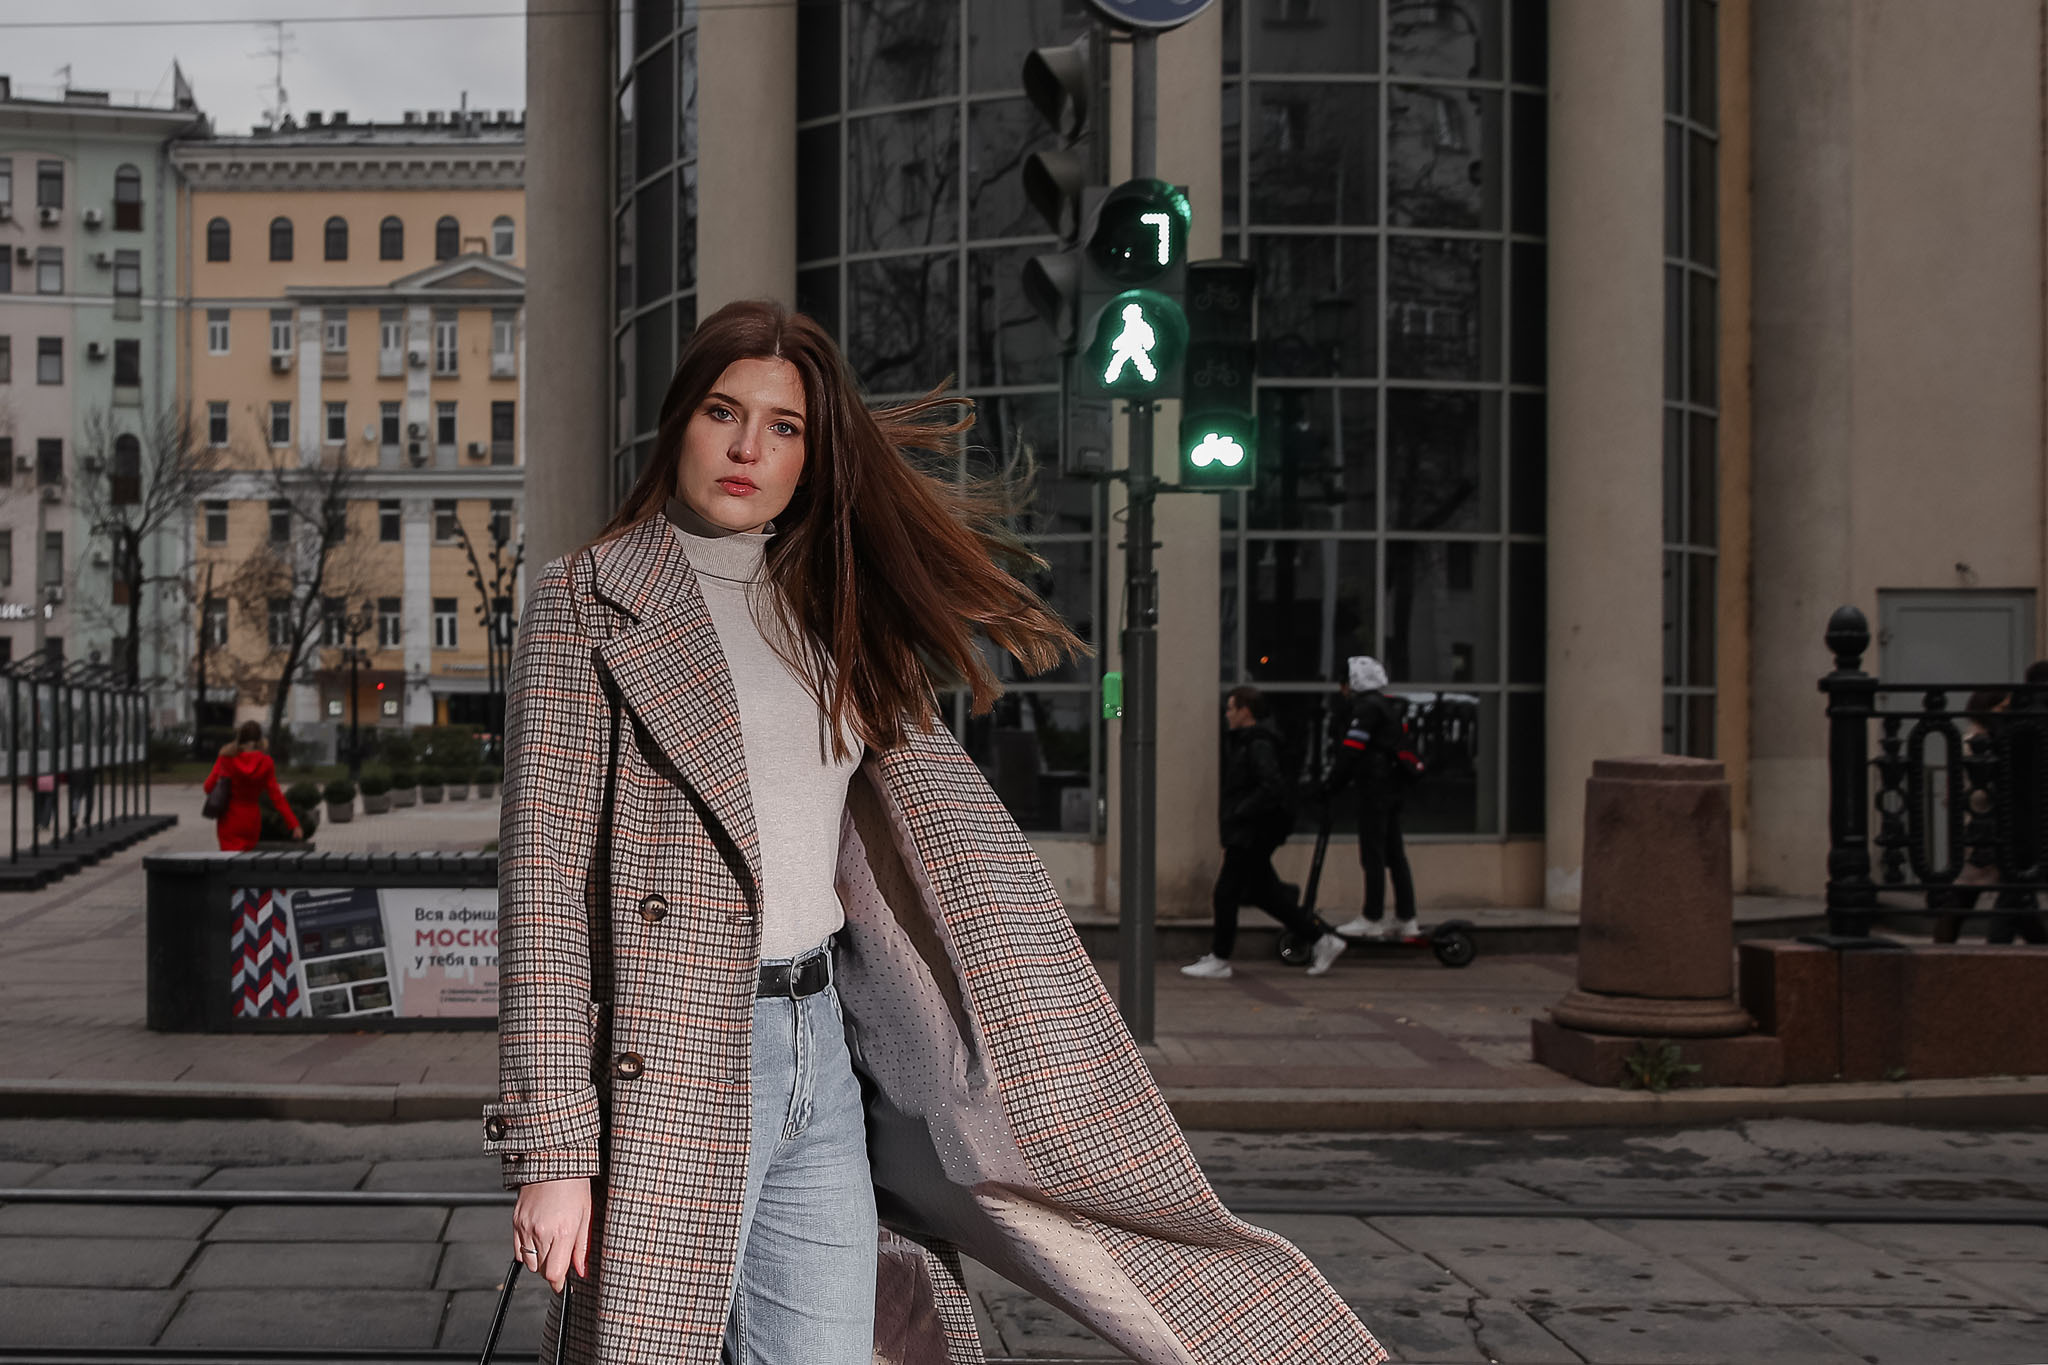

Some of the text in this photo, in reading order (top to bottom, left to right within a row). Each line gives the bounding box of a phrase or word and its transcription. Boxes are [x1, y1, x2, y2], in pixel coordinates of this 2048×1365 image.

[1140, 213, 1169, 265] 7
[415, 907, 443, 921] Вся
[415, 956, 424, 969] у
[429, 952, 464, 966] тебя
[470, 956, 478, 966] в
